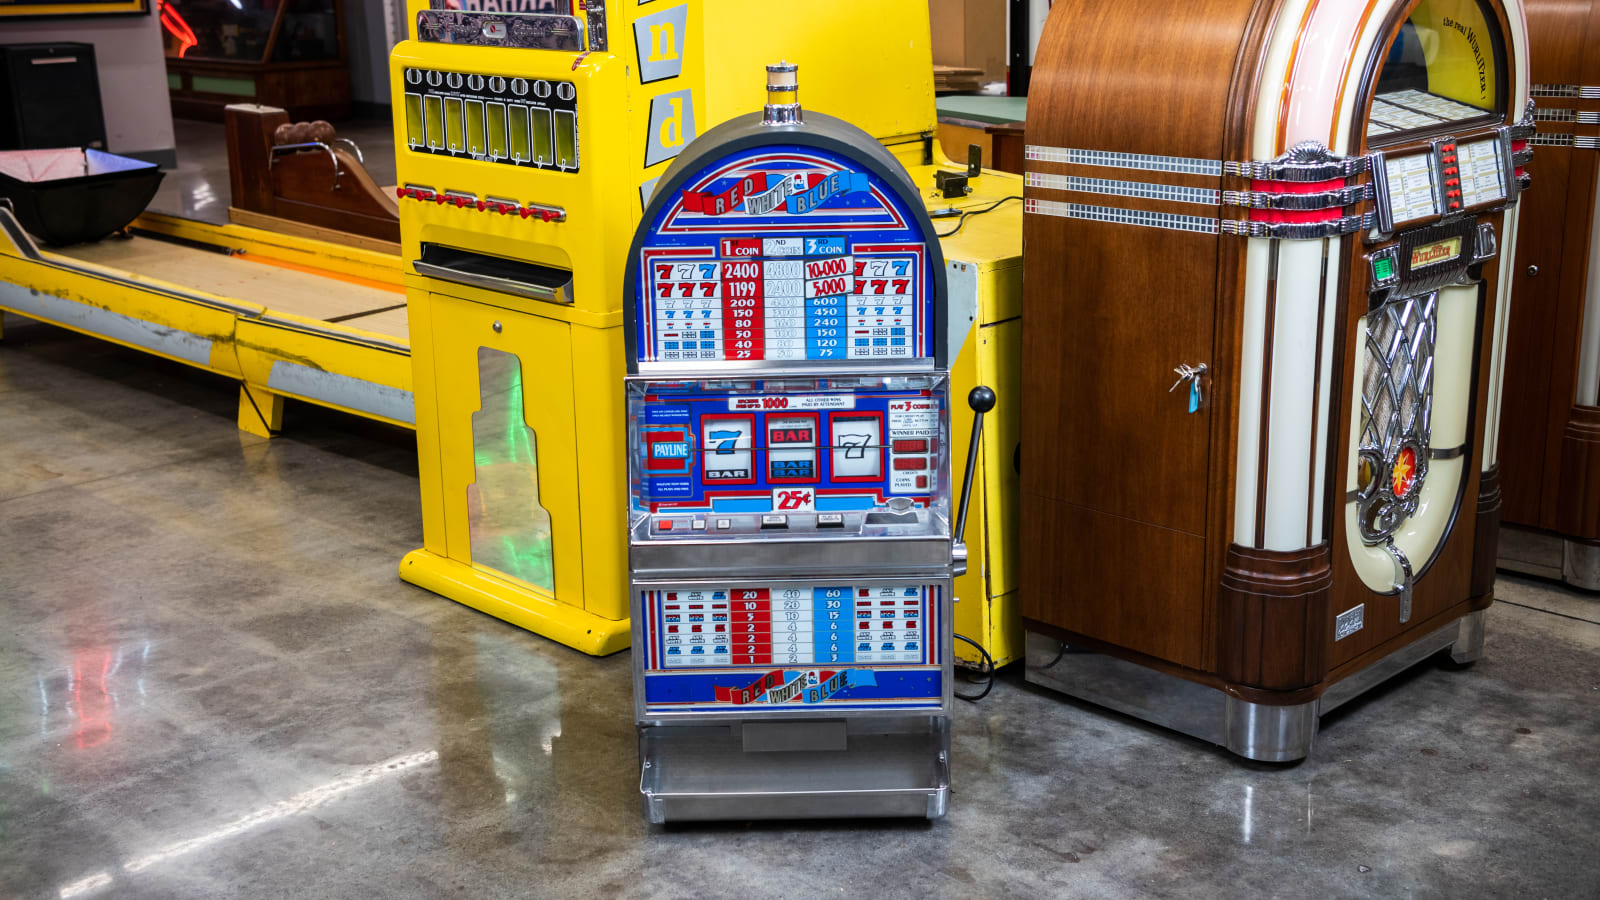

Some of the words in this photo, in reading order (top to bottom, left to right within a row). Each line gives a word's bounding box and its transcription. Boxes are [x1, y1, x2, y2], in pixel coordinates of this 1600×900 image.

[1443, 16, 1453, 26] the
[1454, 21, 1467, 36] real
[648, 21, 679, 63] n
[660, 97, 684, 148] d
[794, 174, 804, 189] &
[715, 178, 753, 213] RED
[748, 179, 793, 214] WHITE
[796, 174, 840, 212] BLUE
[736, 248, 759, 256] COIN
[819, 246, 842, 254] COIN
[724, 263, 758, 278] 2400
[766, 262, 801, 277] 4800
[807, 258, 846, 278] 10,000
[729, 281, 756, 297] 1199
[766, 280, 801, 296] 2400
[813, 278, 846, 296] 5,000
[730, 299, 755, 307] 200
[813, 297, 838, 305] 600
[733, 309, 753, 317] 150
[814, 307, 837, 316] 450
[735, 320, 751, 328] 80
[814, 318, 838, 326] 240
[736, 330, 751, 338] 50
[816, 328, 836, 337] 150
[735, 340, 752, 348] 40
[816, 338, 837, 347] 120
[736, 350, 751, 358] 25
[820, 349, 832, 357] 75
[762, 398, 788, 409] 1000
[772, 430, 810, 442] BAR
[655, 444, 688, 456] PAYLINE
[708, 470, 746, 478] BAR
[778, 490, 812, 510] 25¢
[742, 591, 758, 600] 20
[783, 590, 800, 598] 40
[826, 589, 841, 598] 60
[744, 602, 756, 610] 10
[784, 601, 800, 610] 20
[826, 600, 841, 609] 30
[747, 613, 754, 621] 5
[785, 612, 799, 621] 10
[829, 612, 840, 620] 15
[747, 624, 755, 632] 2
[787, 622, 797, 631] 4
[830, 622, 838, 630] 6
[747, 634, 755, 642] 2
[787, 633, 797, 642] 4
[830, 633, 838, 641] 6
[747, 646, 755, 654] 2
[788, 644, 798, 653] 4
[749, 656, 754, 664] 1
[789, 654, 798, 664] 2
[831, 654, 838, 662] 3
[808, 671, 817, 684] &
[742, 675, 774, 704] RED
[770, 673, 807, 704] WHITE
[810, 671, 848, 702] BLUE
